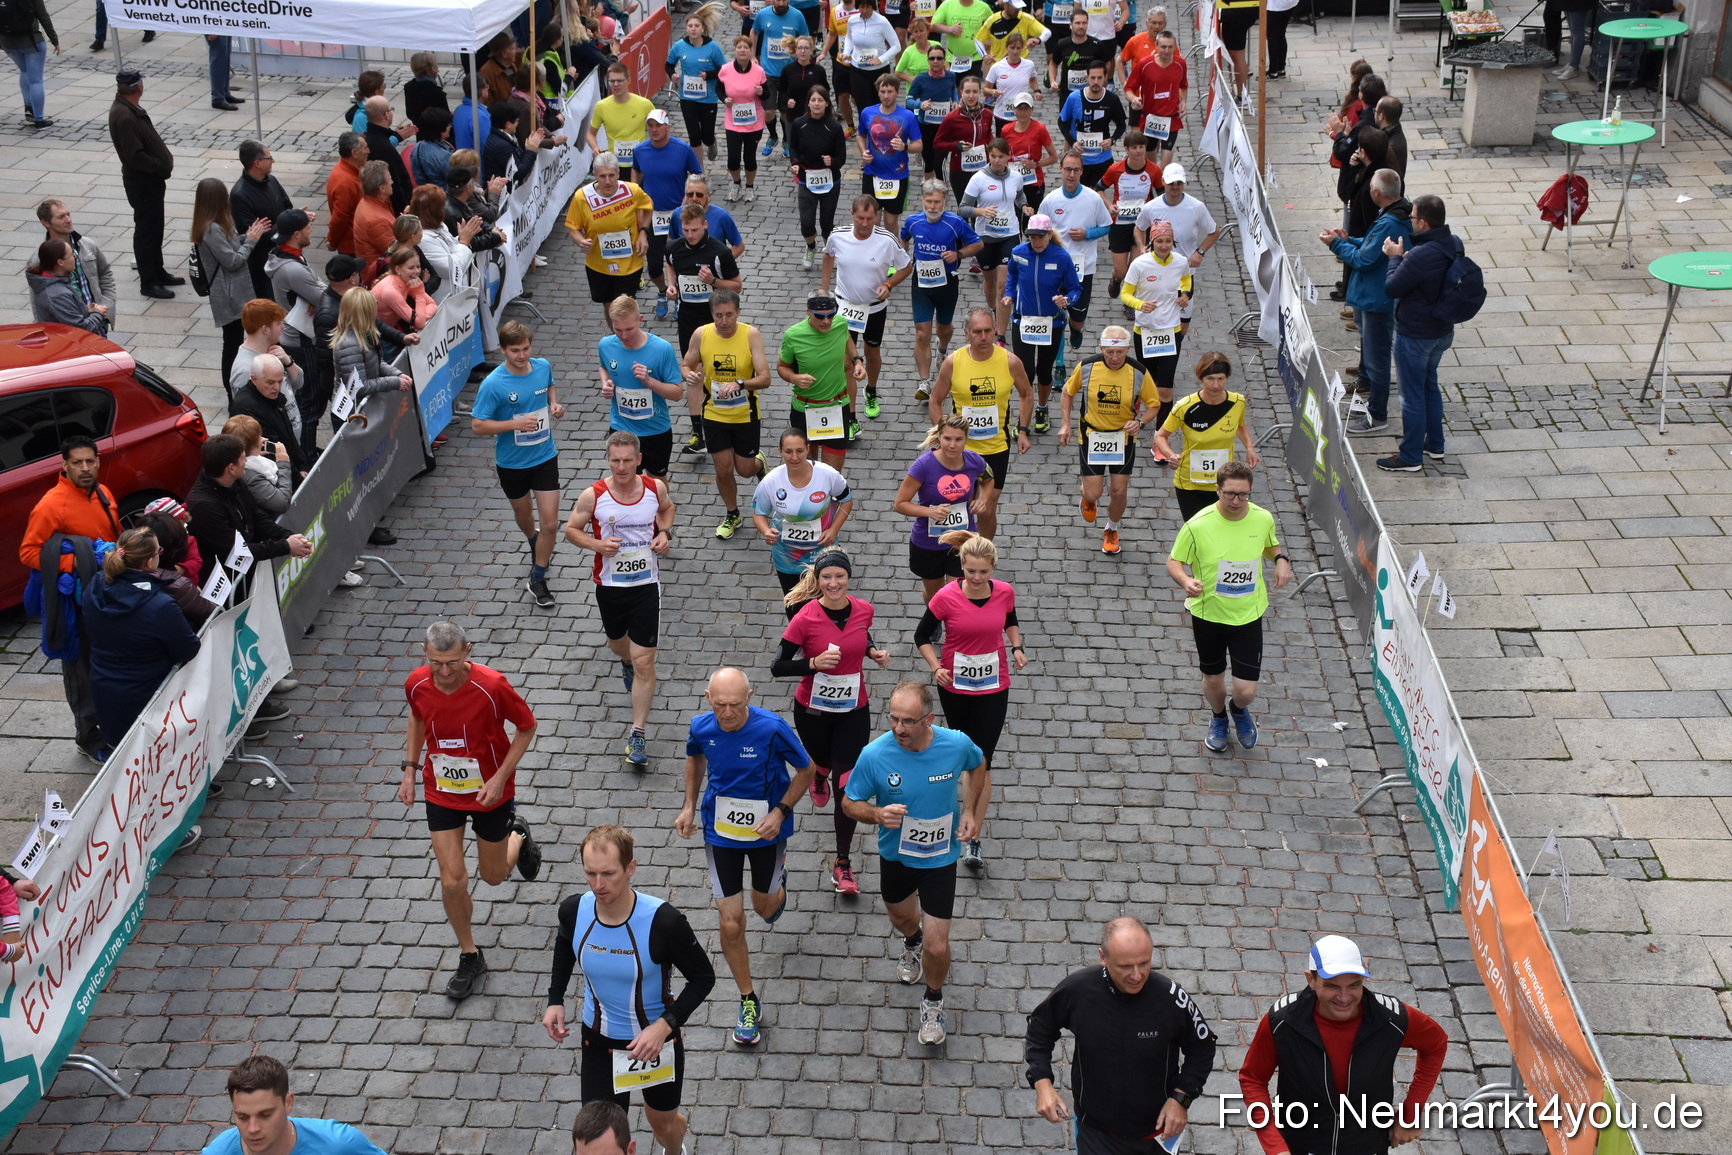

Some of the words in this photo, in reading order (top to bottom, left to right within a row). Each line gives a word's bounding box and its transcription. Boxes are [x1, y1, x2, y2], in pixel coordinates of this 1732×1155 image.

[175, 0, 313, 17] ConnectedDrive
[124, 8, 179, 25] Vernetzt,
[182, 15, 200, 24] um
[203, 14, 222, 26] frei
[226, 19, 239, 27] zu
[242, 18, 271, 30] sein.
[687, 82, 703, 91] 2514
[735, 109, 753, 118] 2084
[929, 108, 947, 116] 2916
[1148, 121, 1167, 131] 2317
[965, 153, 983, 163] 2006
[810, 176, 828, 184] 2311
[879, 182, 893, 190] 239
[593, 210, 613, 221] MAX
[613, 200, 635, 215] BÖGL
[989, 217, 1009, 227] 2532
[604, 238, 627, 249] 2638
[918, 242, 947, 252] SYSCAD
[920, 268, 941, 278] 2466
[683, 283, 708, 293] 2313
[842, 307, 865, 321] 2472
[1024, 324, 1047, 334] 2923
[1146, 334, 1171, 345] 2799
[621, 396, 648, 409] 2478
[820, 416, 828, 427] 9
[1192, 422, 1208, 430] Birgit
[1093, 441, 1118, 452] 2921
[1203, 461, 1215, 470] 51
[787, 528, 815, 540] 2221
[616, 559, 647, 573] 2366
[1223, 571, 1252, 584] 2294
[211, 576, 226, 598] swn
[960, 664, 993, 679] 2019
[819, 684, 852, 698] 2274
[442, 766, 468, 780] 200
[929, 771, 955, 782] BOCK
[726, 809, 755, 825] 429
[909, 827, 945, 844] 2216
[21, 841, 42, 869] swn
[76, 935, 126, 1016] Service-Line:
[1522, 957, 1546, 1003] Neumarkts
[1137, 1030, 1159, 1038] FALKE
